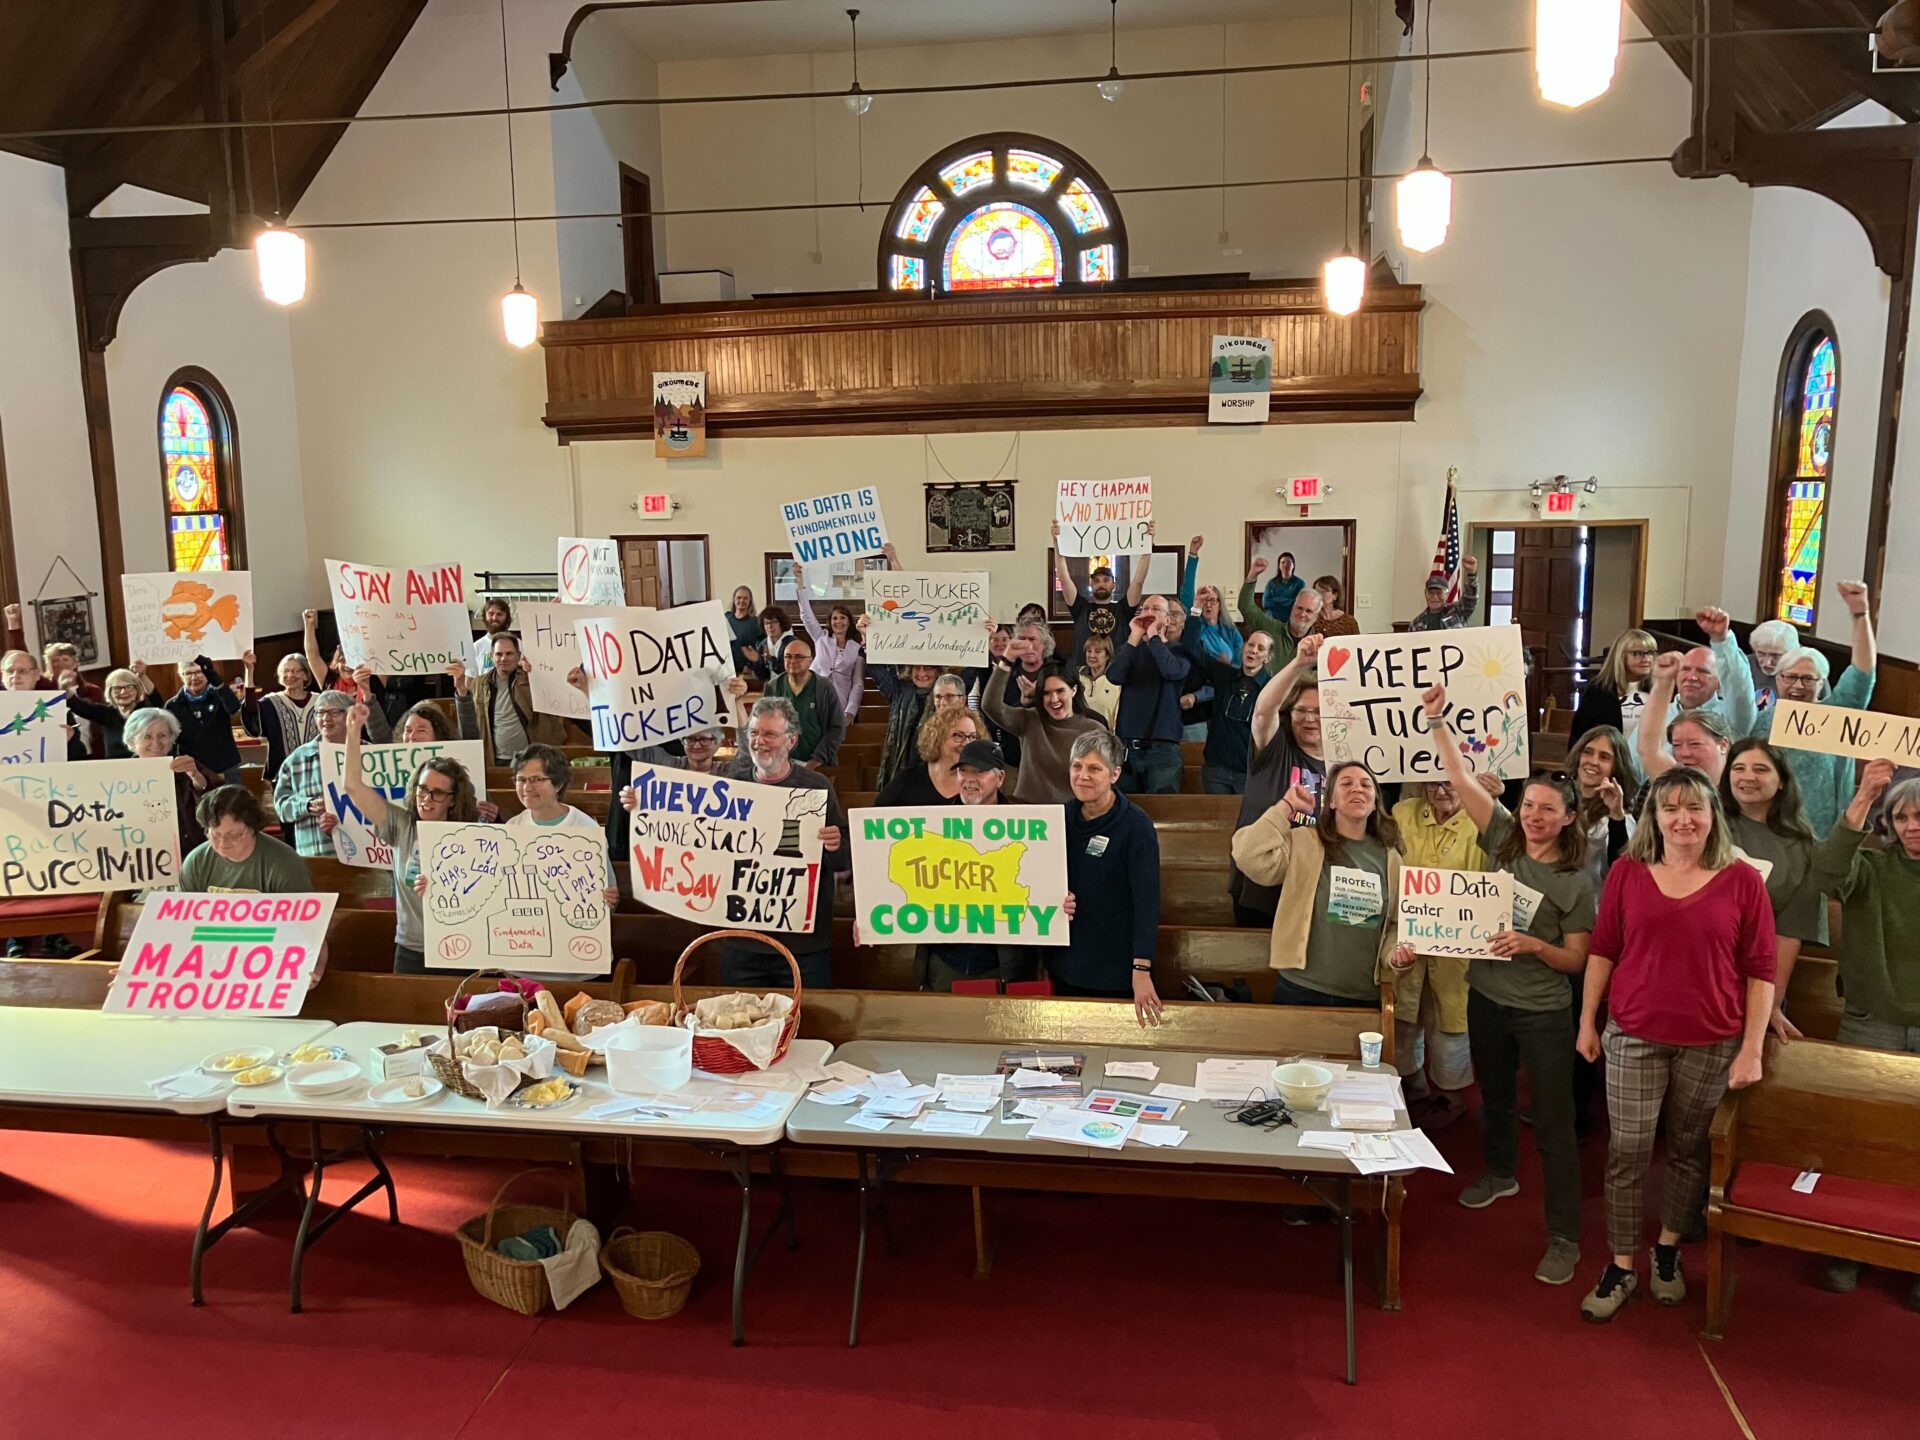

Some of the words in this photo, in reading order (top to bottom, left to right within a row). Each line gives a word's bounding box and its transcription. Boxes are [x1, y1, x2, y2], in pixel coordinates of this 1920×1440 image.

[1221, 399, 1255, 408] WORSHIP
[1060, 482, 1087, 497] HEY
[1293, 479, 1318, 496] EXIT
[644, 496, 666, 512] EXIT
[784, 502, 809, 521] BIG
[813, 493, 852, 515] DATA
[858, 489, 873, 507] IS
[1060, 500, 1091, 522] WHO
[1096, 500, 1152, 521] INVITED
[1549, 494, 1574, 512] EXIT
[790, 511, 876, 538] FUNDAMENTALLY
[795, 526, 882, 562] WRONG
[1072, 521, 1149, 553] YOU?
[340, 563, 391, 604] STAY
[406, 564, 463, 605] AWAY
[871, 578, 911, 598] KEEP
[915, 578, 980, 599] TUCKER
[583, 624, 623, 680] NO
[629, 626, 726, 676] DATA
[873, 633, 908, 650] Wild
[910, 642, 925, 651] and
[927, 633, 987, 659] Wonderful!
[1357, 645, 1464, 689] KEEP
[631, 683, 654, 705] IN
[1785, 709, 1830, 736] No!
[1840, 715, 1887, 747] No!
[335, 745, 444, 776] POTECT
[2, 775, 79, 799] Take
[100, 779, 160, 808] your
[633, 768, 706, 815] THEY
[704, 780, 754, 822] SAY
[48, 799, 124, 829] Data
[863, 817, 926, 840] NOT
[942, 817, 973, 840] IN
[982, 818, 1048, 841] OUR
[441, 843, 467, 860] CO2
[475, 838, 499, 856] PM
[537, 845, 564, 860] SO2
[573, 850, 593, 862] CO
[471, 857, 497, 878] Lead
[906, 855, 998, 893] TUCKER
[571, 876, 588, 893] PM
[1335, 876, 1377, 890] PROTECT
[1404, 869, 1441, 896] NO
[1450, 873, 1500, 898] Data
[157, 898, 322, 922] MICROGRID
[870, 903, 1058, 936] COUNTY
[1400, 899, 1444, 918] Center
[493, 926, 546, 938] Fundamental
[1405, 918, 1463, 941] Tucker
[443, 938, 467, 957] NO
[509, 939, 534, 950] Data
[571, 940, 597, 954] NO
[132, 942, 306, 981] MAJOR
[126, 981, 292, 1010] TROUBLE
